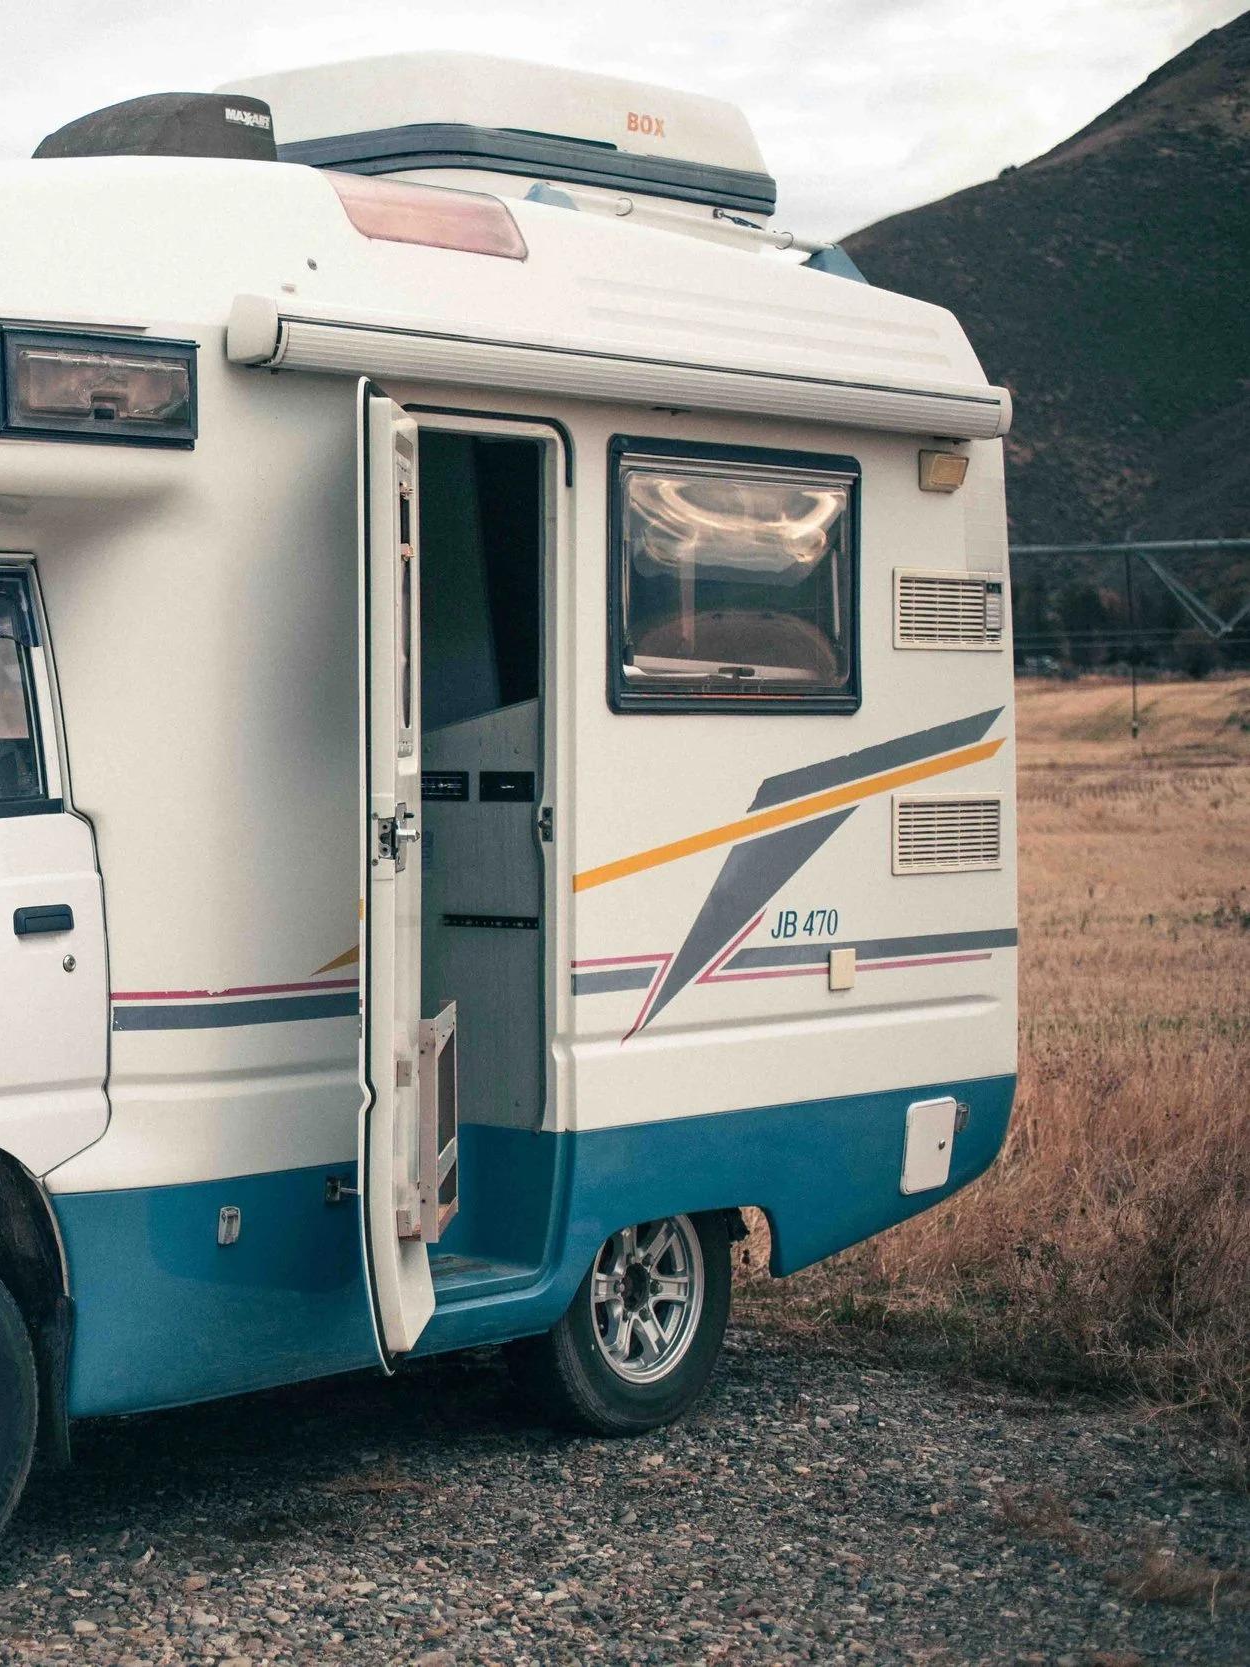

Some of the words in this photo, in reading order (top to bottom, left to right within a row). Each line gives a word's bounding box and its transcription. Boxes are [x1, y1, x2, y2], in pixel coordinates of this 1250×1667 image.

[627, 111, 665, 138] BOX
[771, 910, 798, 939] JB
[803, 908, 838, 936] 470
